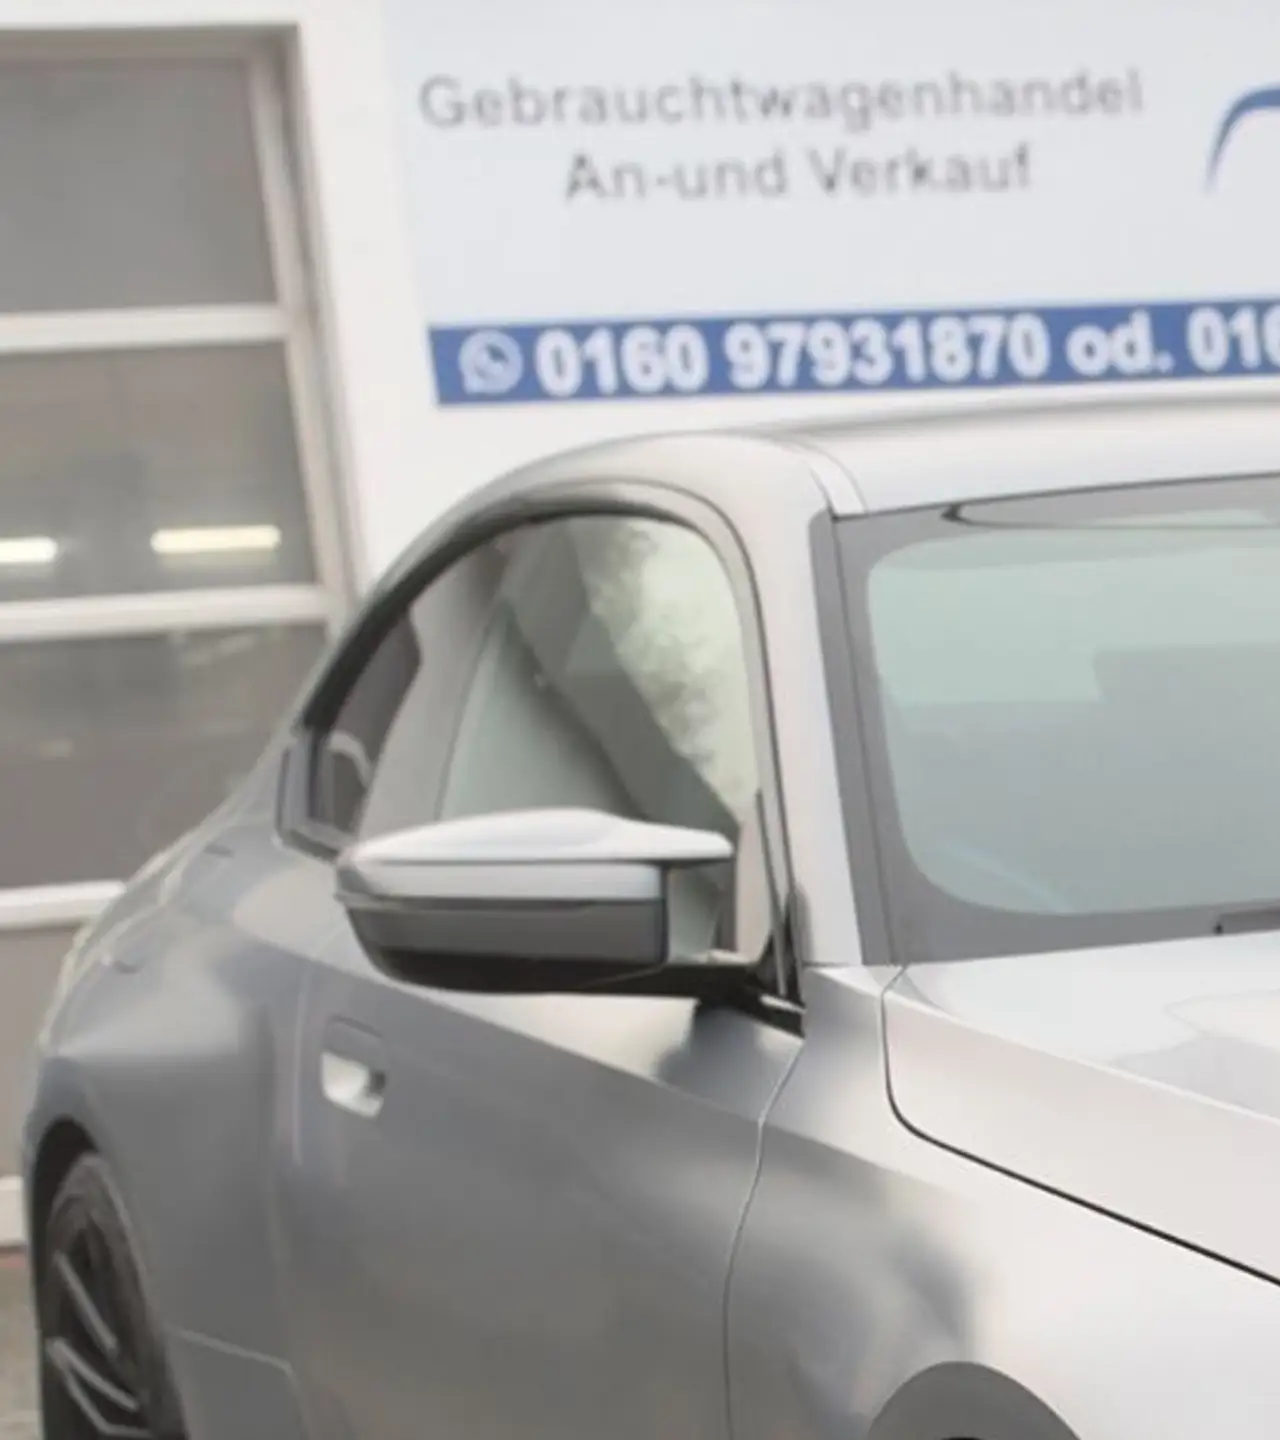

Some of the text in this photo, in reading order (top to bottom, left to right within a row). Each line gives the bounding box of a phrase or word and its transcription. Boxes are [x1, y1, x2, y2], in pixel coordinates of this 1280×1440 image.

[418, 66, 1146, 132] Gebrauchtwagenhandel
[807, 142, 1034, 196] Verkauf
[534, 323, 710, 397] 0160
[724, 312, 1049, 390] 97931870
[1065, 312, 1174, 375] od.
